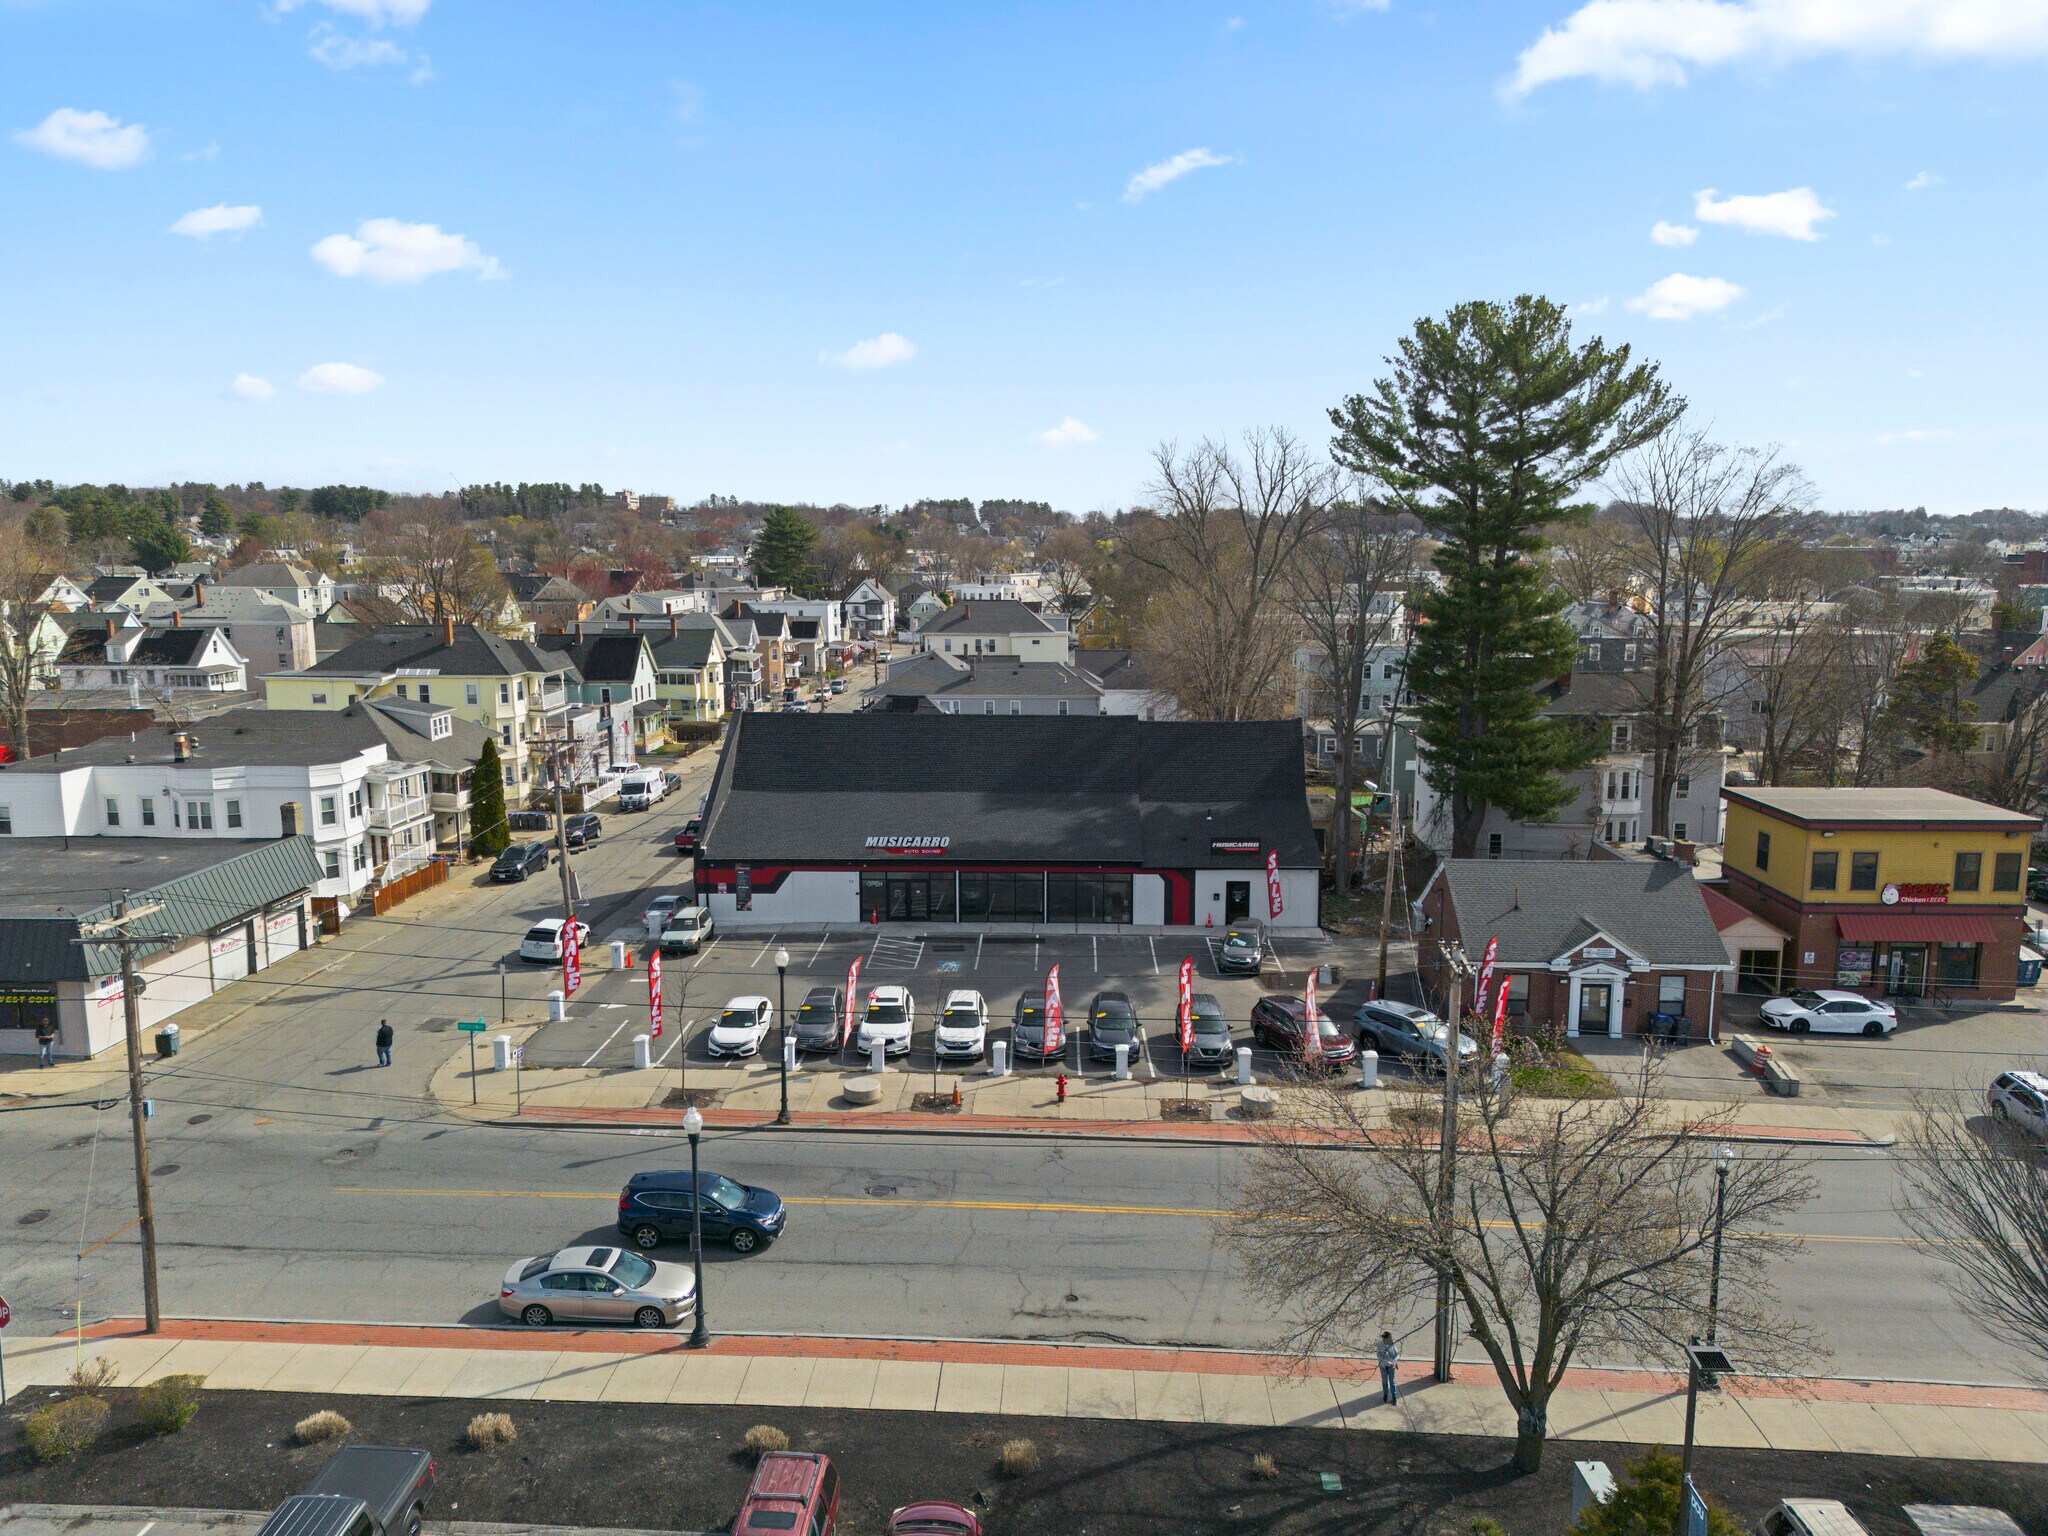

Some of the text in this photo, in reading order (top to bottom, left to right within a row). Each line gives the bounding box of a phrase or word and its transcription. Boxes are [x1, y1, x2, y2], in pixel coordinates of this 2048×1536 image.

[865, 836, 950, 847] MUSICARRO
[1268, 853, 1281, 913] SALE
[565, 922, 580, 991] SALE
[1476, 942, 1497, 1014] SALE
[28, 995, 56, 1004] COST
[652, 957, 662, 1035] SALE
[1046, 969, 1060, 1047] SALE
